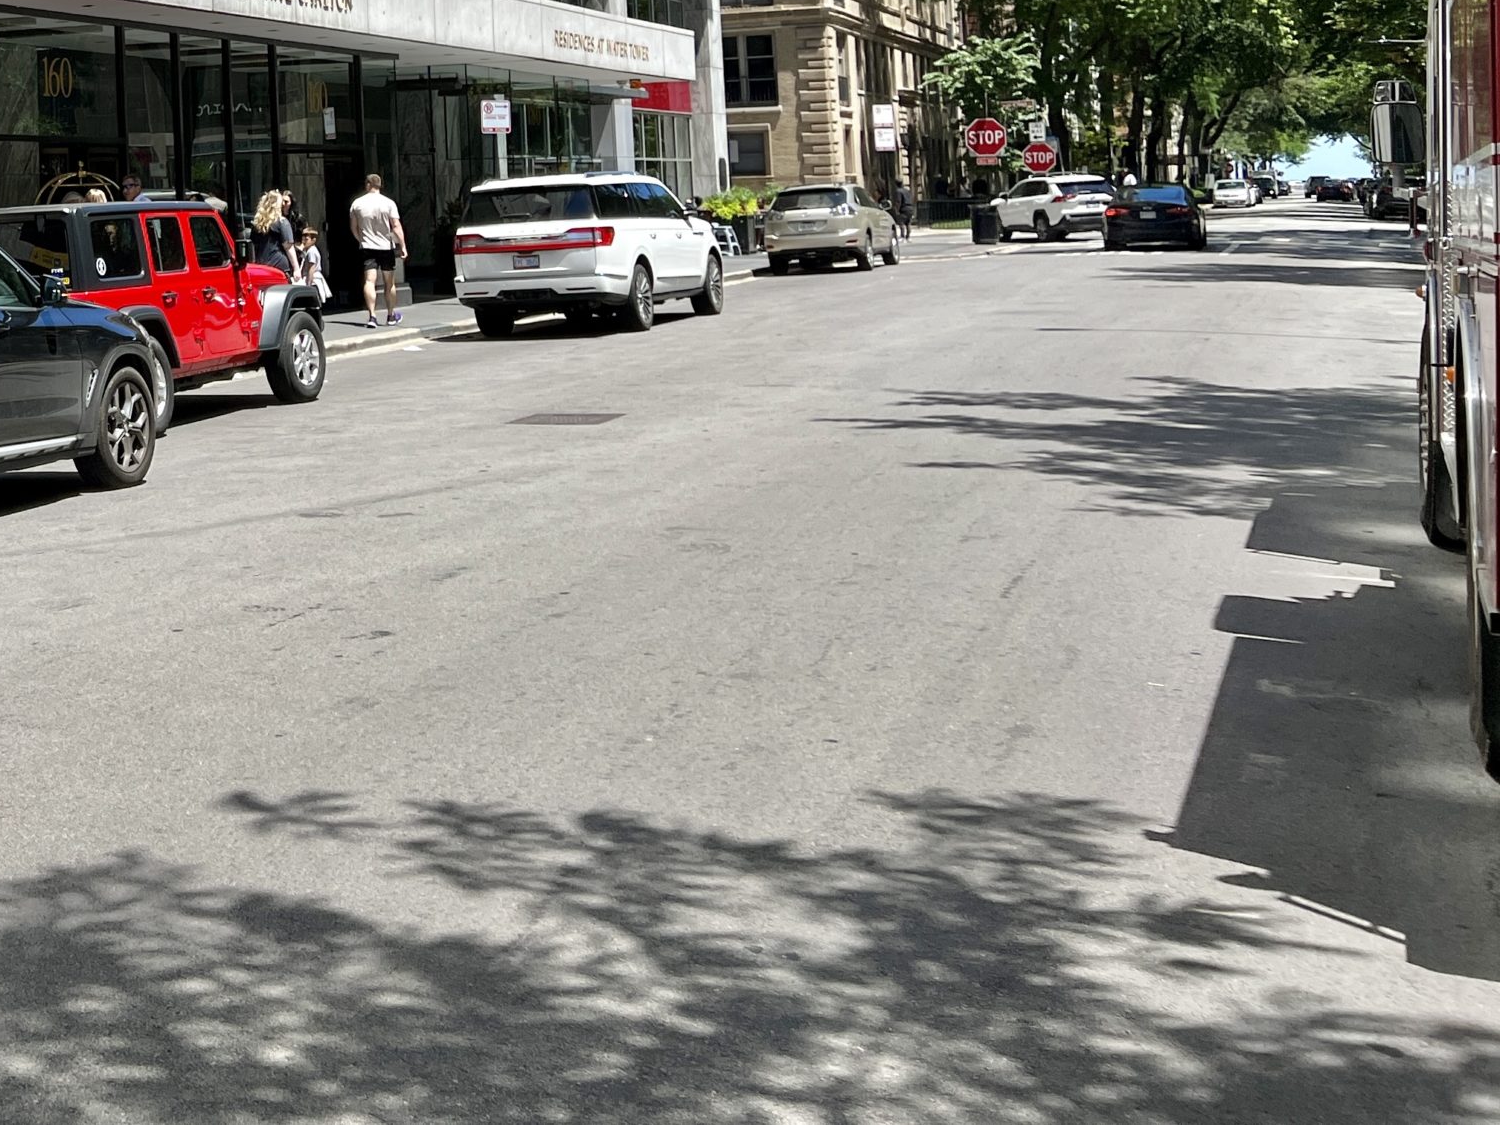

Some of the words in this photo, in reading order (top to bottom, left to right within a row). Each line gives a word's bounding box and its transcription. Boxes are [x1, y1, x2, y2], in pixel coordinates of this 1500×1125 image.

[554, 29, 595, 53] RESIDENCES
[596, 38, 605, 55] AT
[606, 38, 628, 58] WATER
[628, 43, 650, 62] TOWER
[42, 56, 73, 98] 160
[968, 129, 1004, 145] STOP
[1025, 151, 1054, 164] STOP
